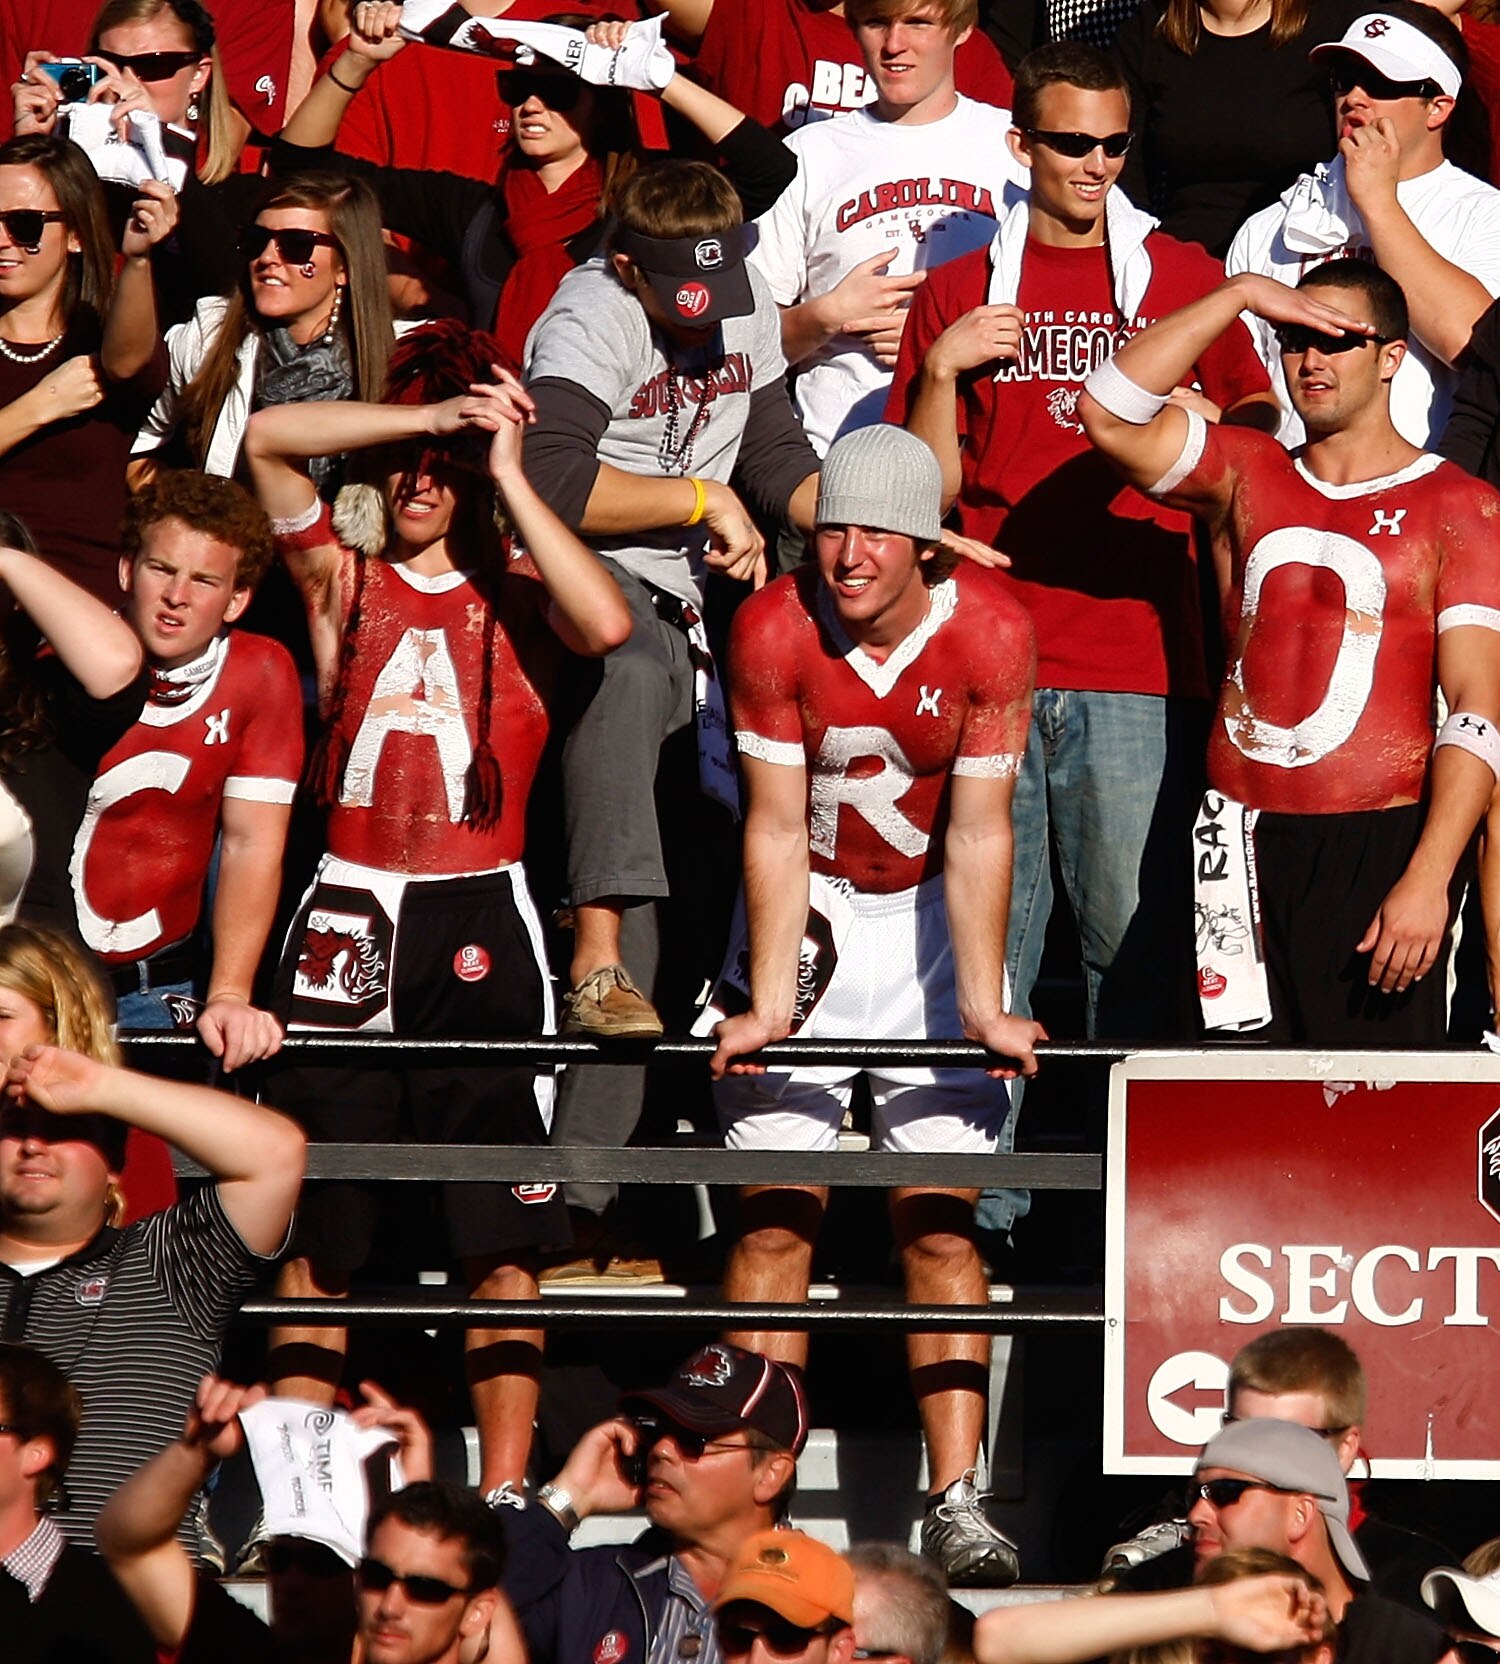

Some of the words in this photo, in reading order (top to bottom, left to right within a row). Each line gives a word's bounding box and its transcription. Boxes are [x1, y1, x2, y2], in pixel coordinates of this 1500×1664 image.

[836, 177, 997, 233] CAROLINA
[340, 627, 472, 823] A
[809, 725, 932, 861] R
[68, 750, 193, 954] C
